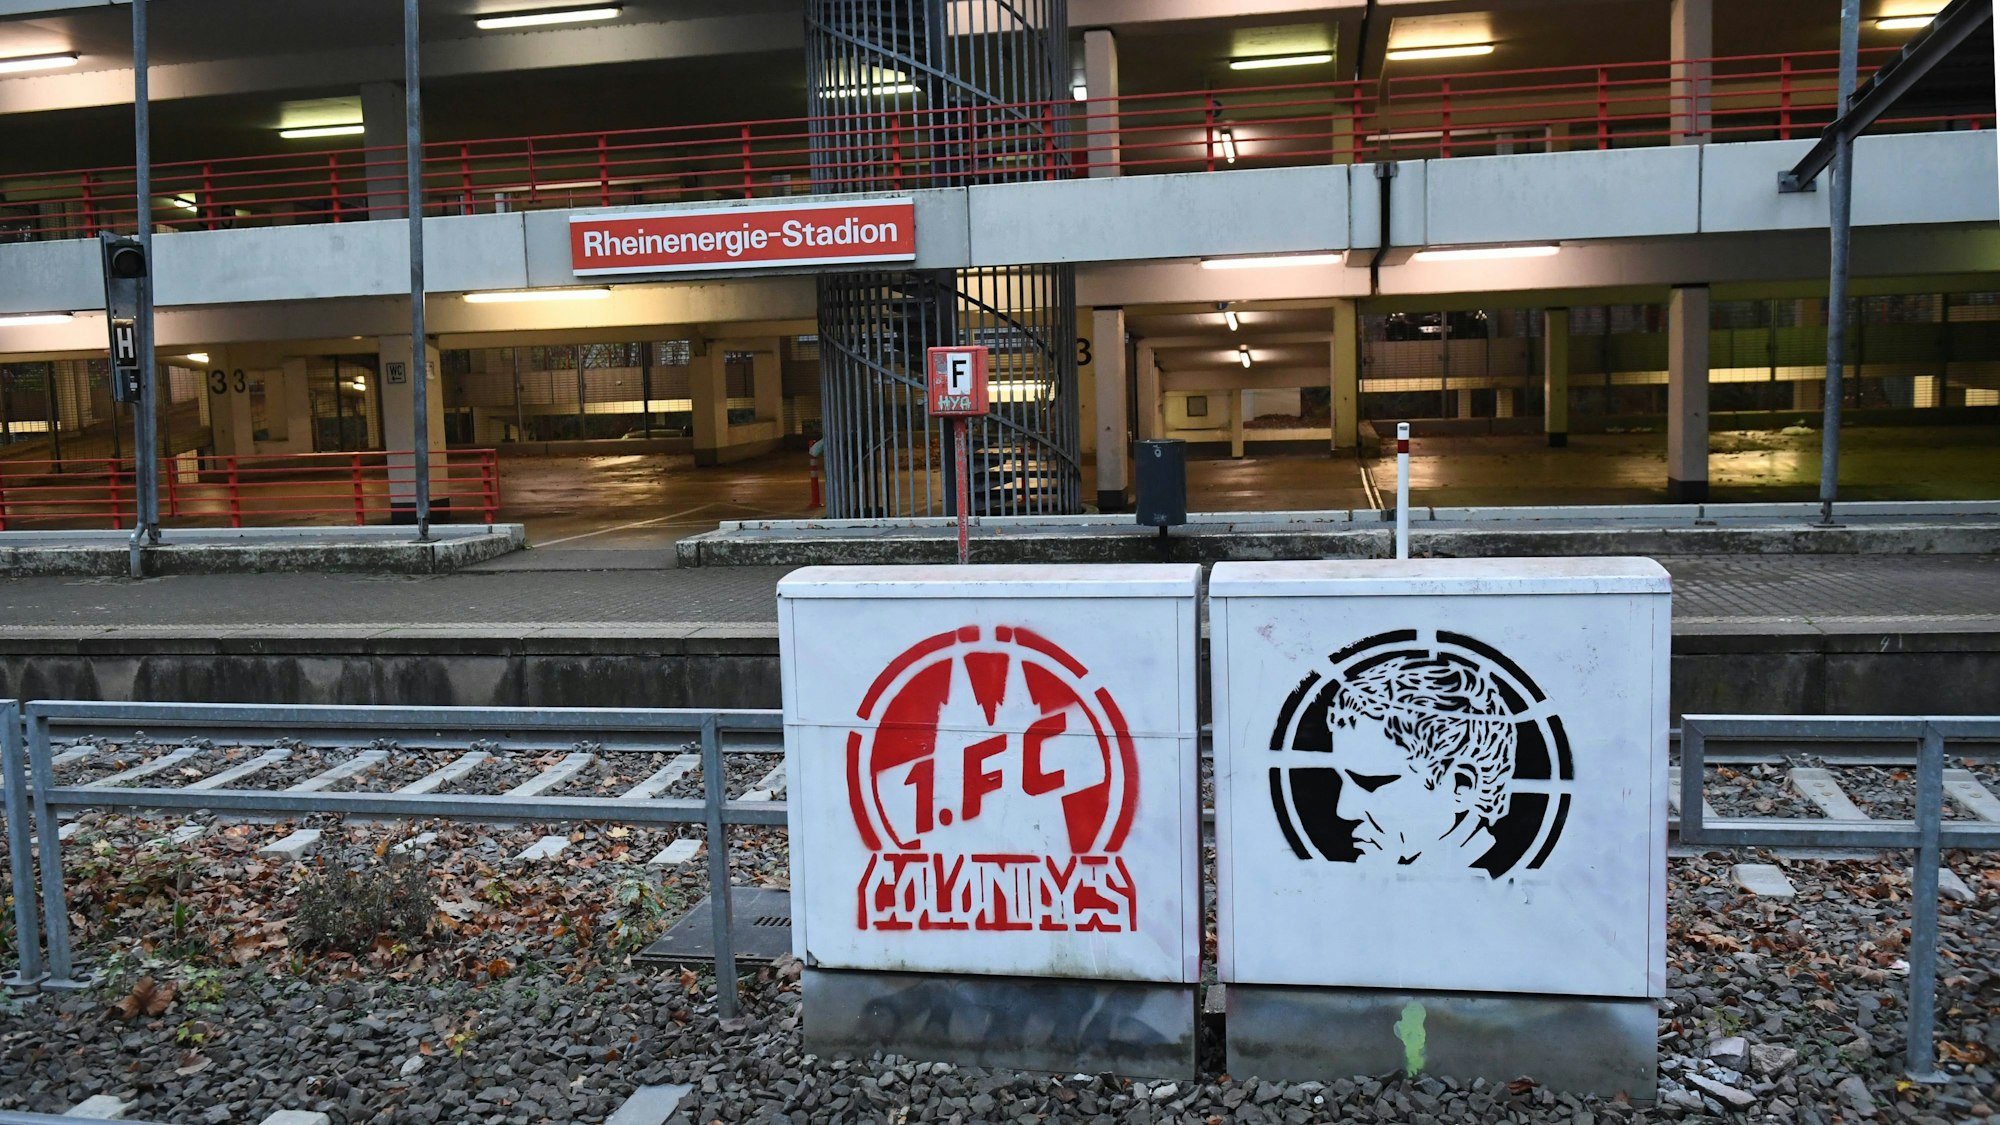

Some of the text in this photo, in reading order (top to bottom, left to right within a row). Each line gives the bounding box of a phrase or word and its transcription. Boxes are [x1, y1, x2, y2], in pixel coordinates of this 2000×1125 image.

[583, 217, 898, 258] Rheinenergie-Stadion
[116, 327, 134, 359] H
[1076, 337, 1092, 366] 3
[389, 364, 403, 376] WC
[952, 359, 967, 388] F
